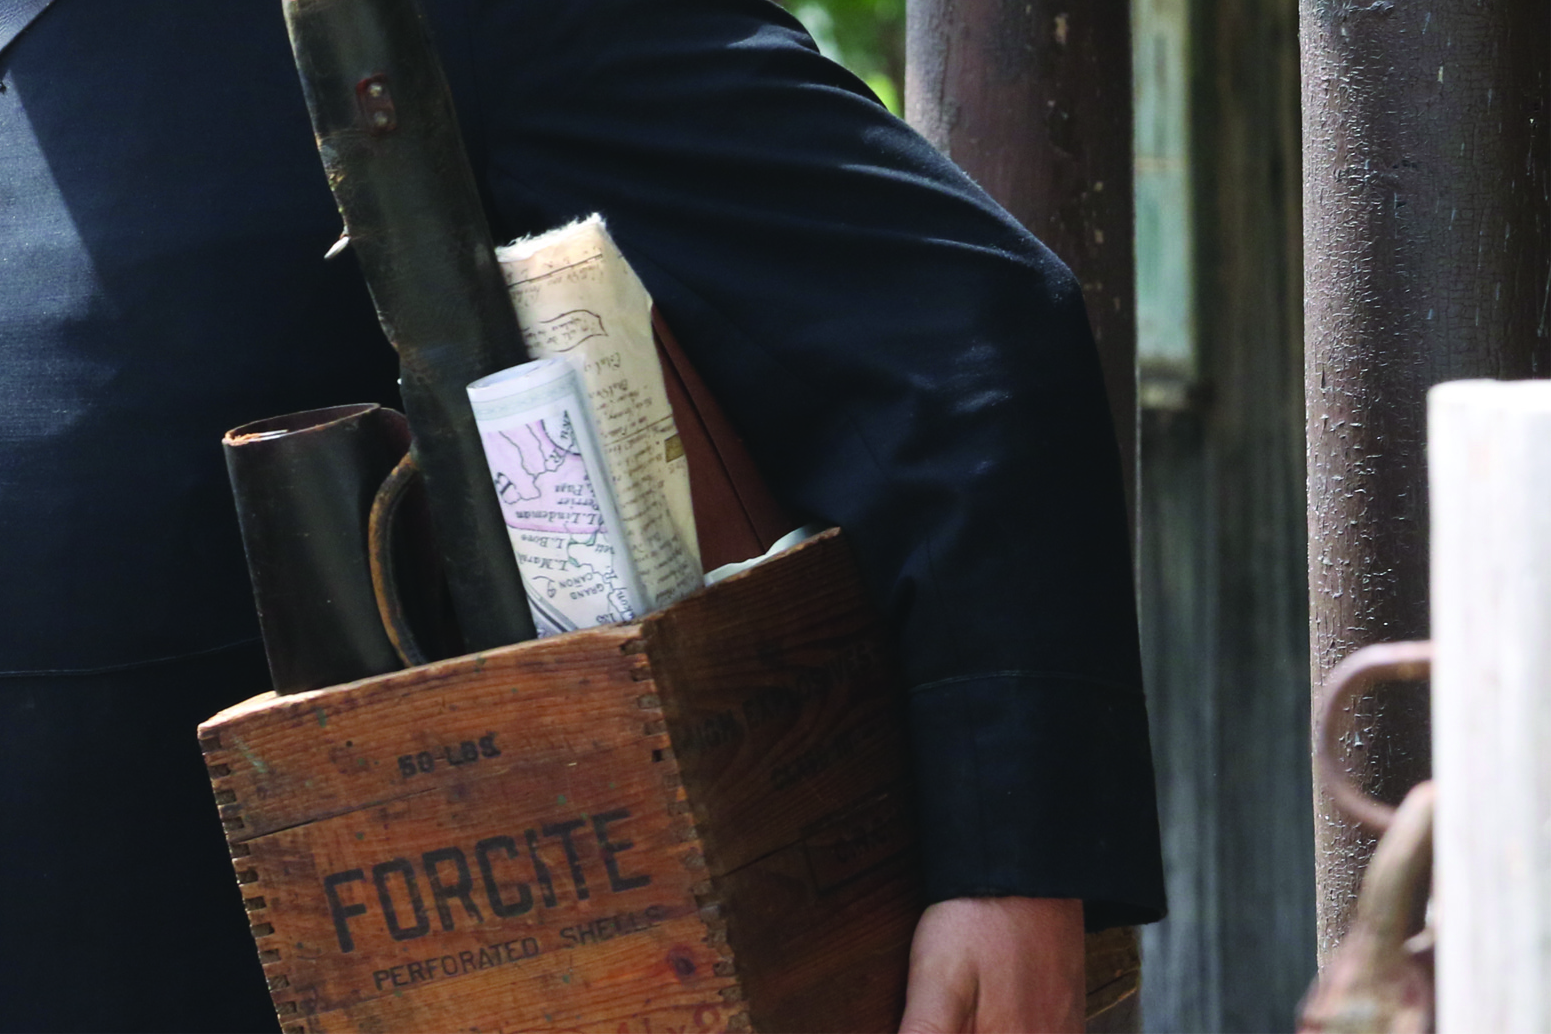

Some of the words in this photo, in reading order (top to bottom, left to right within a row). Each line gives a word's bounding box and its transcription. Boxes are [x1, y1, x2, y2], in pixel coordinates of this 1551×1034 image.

[569, 583, 605, 601] GRAND
[398, 750, 435, 778] 50
[323, 808, 651, 955] FORCITE
[372, 935, 540, 991] PERFORATED
[558, 903, 664, 949] SHELLS
